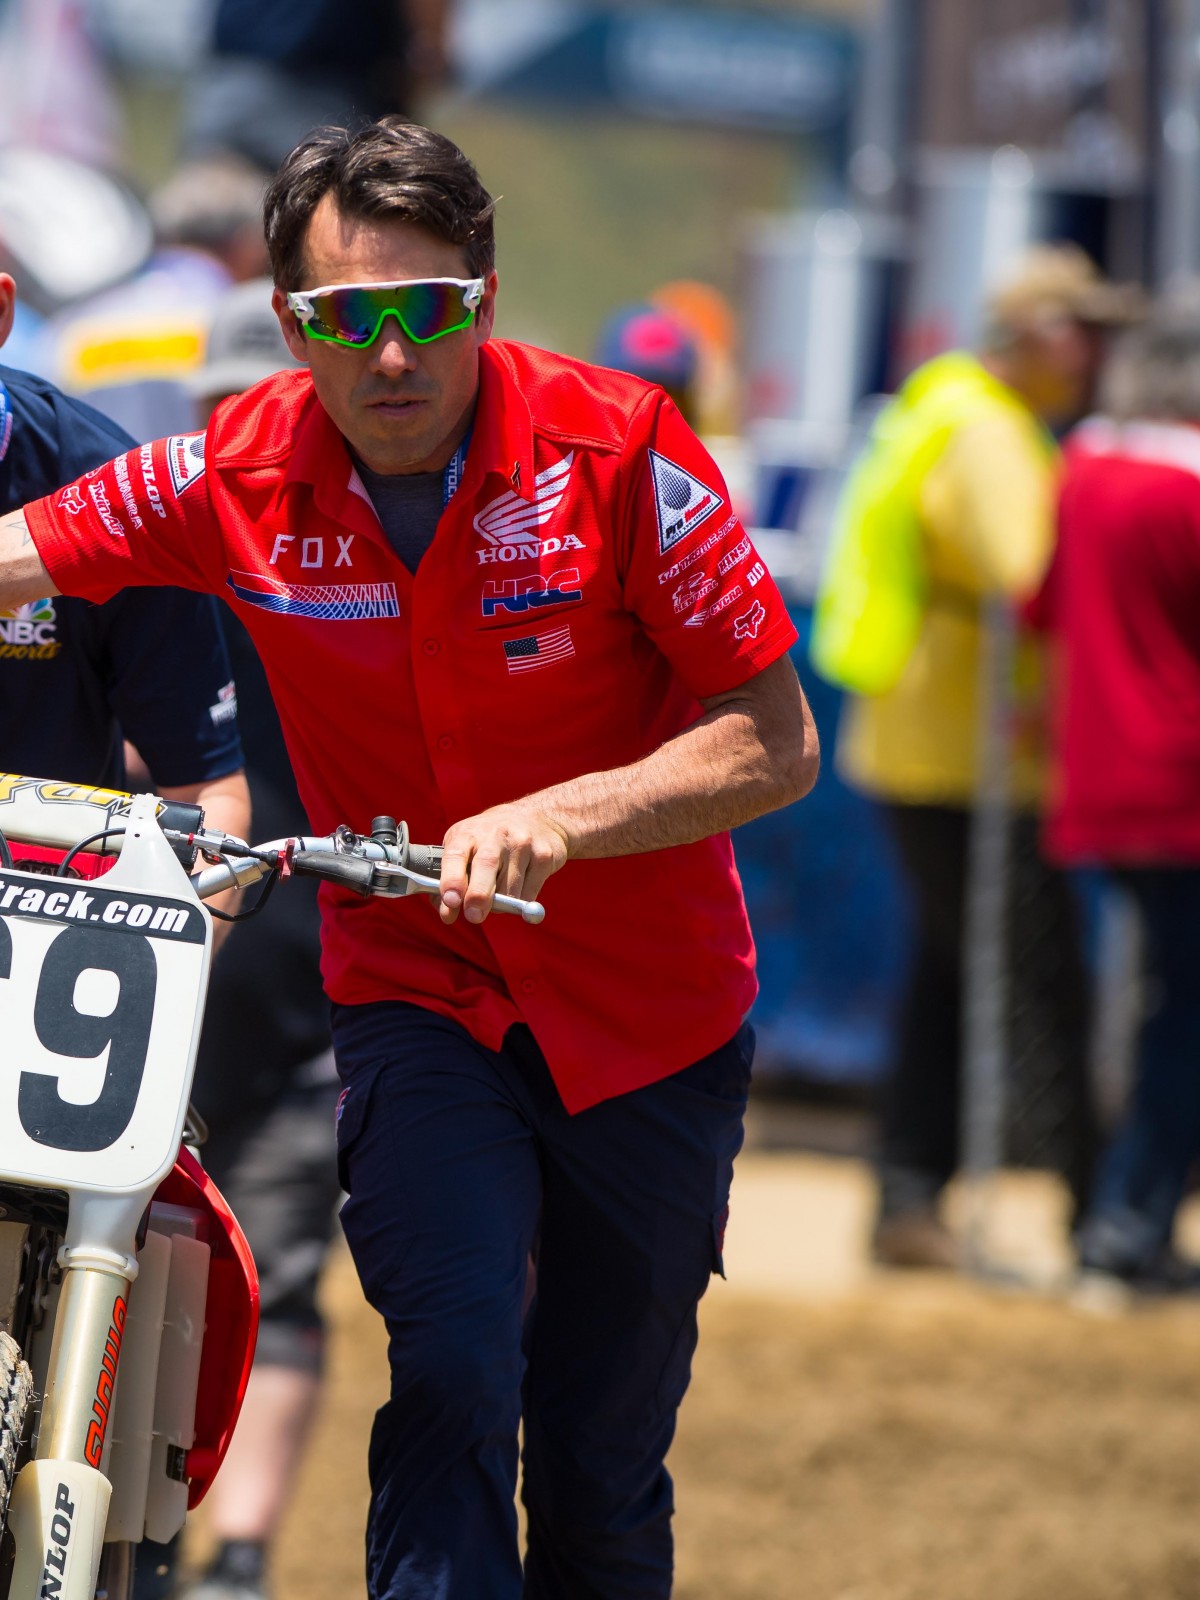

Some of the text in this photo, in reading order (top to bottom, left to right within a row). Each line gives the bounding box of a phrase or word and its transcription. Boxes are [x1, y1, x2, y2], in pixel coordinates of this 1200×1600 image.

[666, 518, 684, 540] Pro
[269, 534, 355, 568] FOX
[475, 533, 586, 565] HONDA
[746, 562, 765, 587] DID
[482, 567, 583, 617] HRC
[673, 580, 719, 614] RENTHAL
[709, 585, 744, 616] CYCRA
[40, 1482, 75, 1600] NLOP
